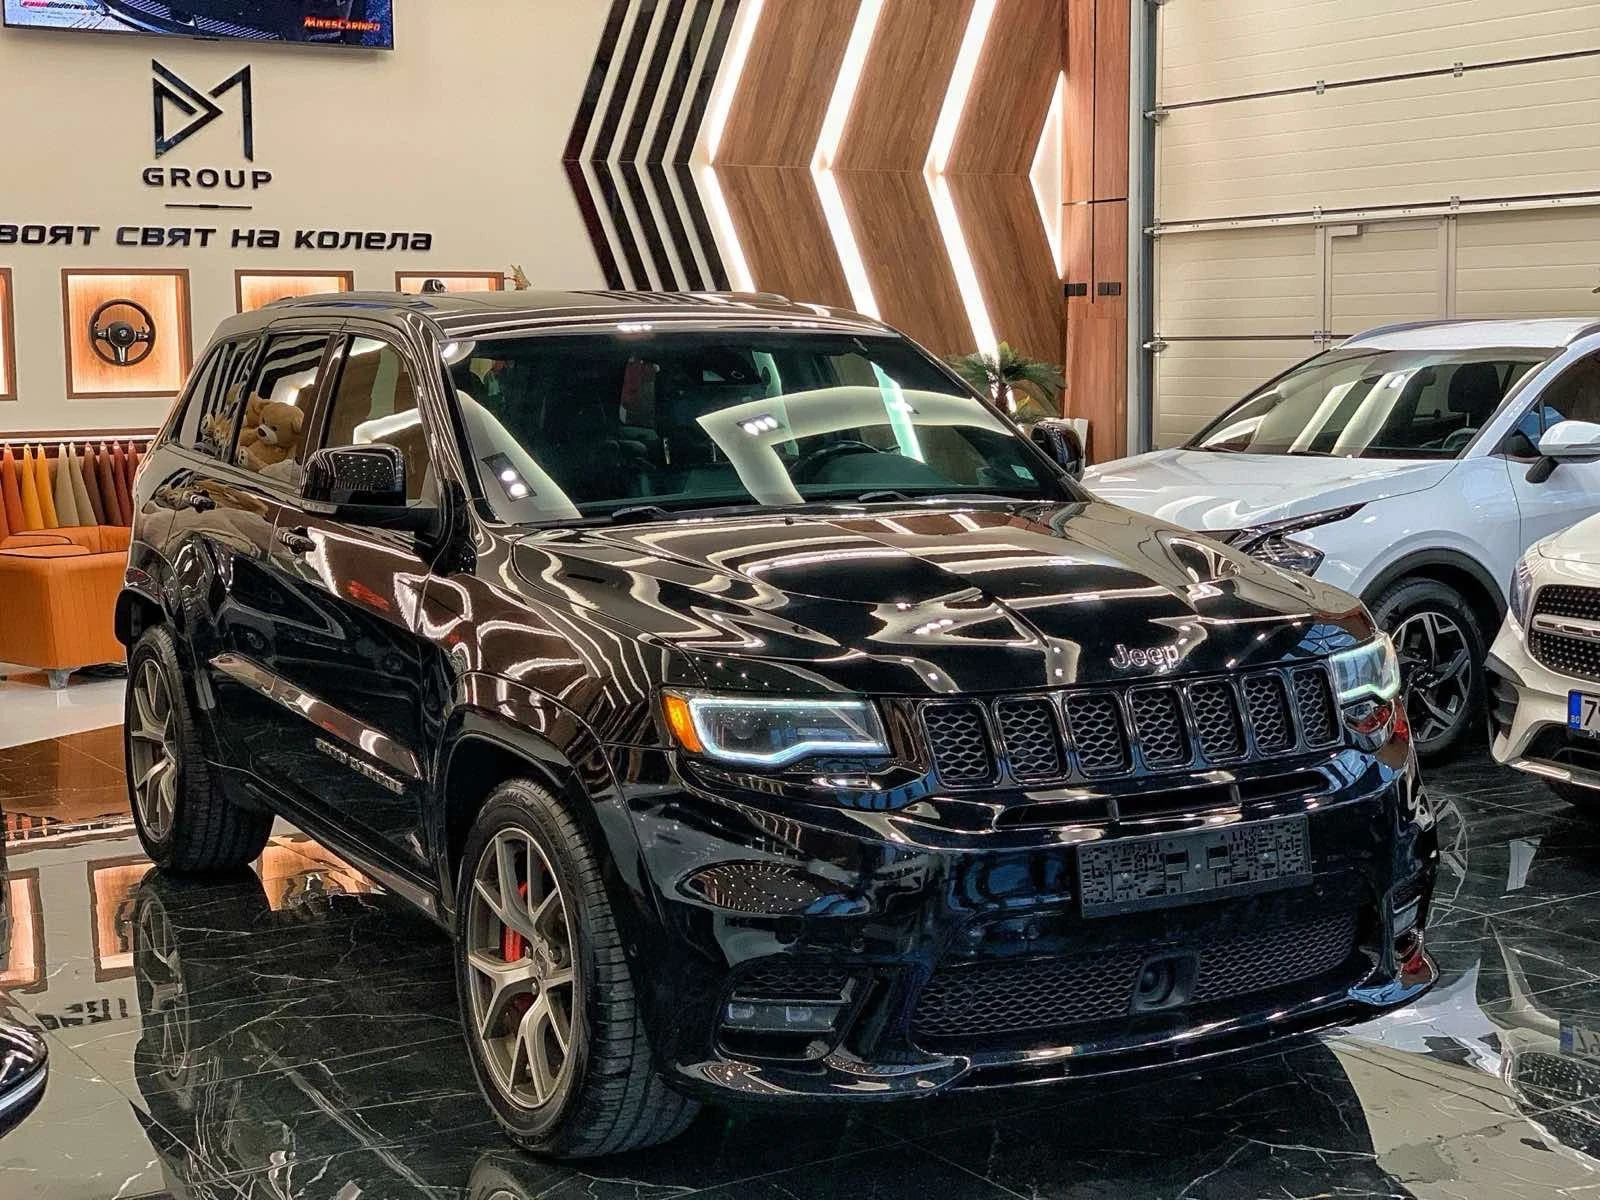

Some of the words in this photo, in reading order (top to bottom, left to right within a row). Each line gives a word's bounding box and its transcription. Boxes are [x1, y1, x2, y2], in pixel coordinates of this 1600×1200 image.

[142, 166, 273, 190] GROUP
[231, 228, 281, 248] на
[294, 229, 433, 251] колела
[1109, 643, 1179, 670] Jeep
[1583, 698, 1600, 727] 7
